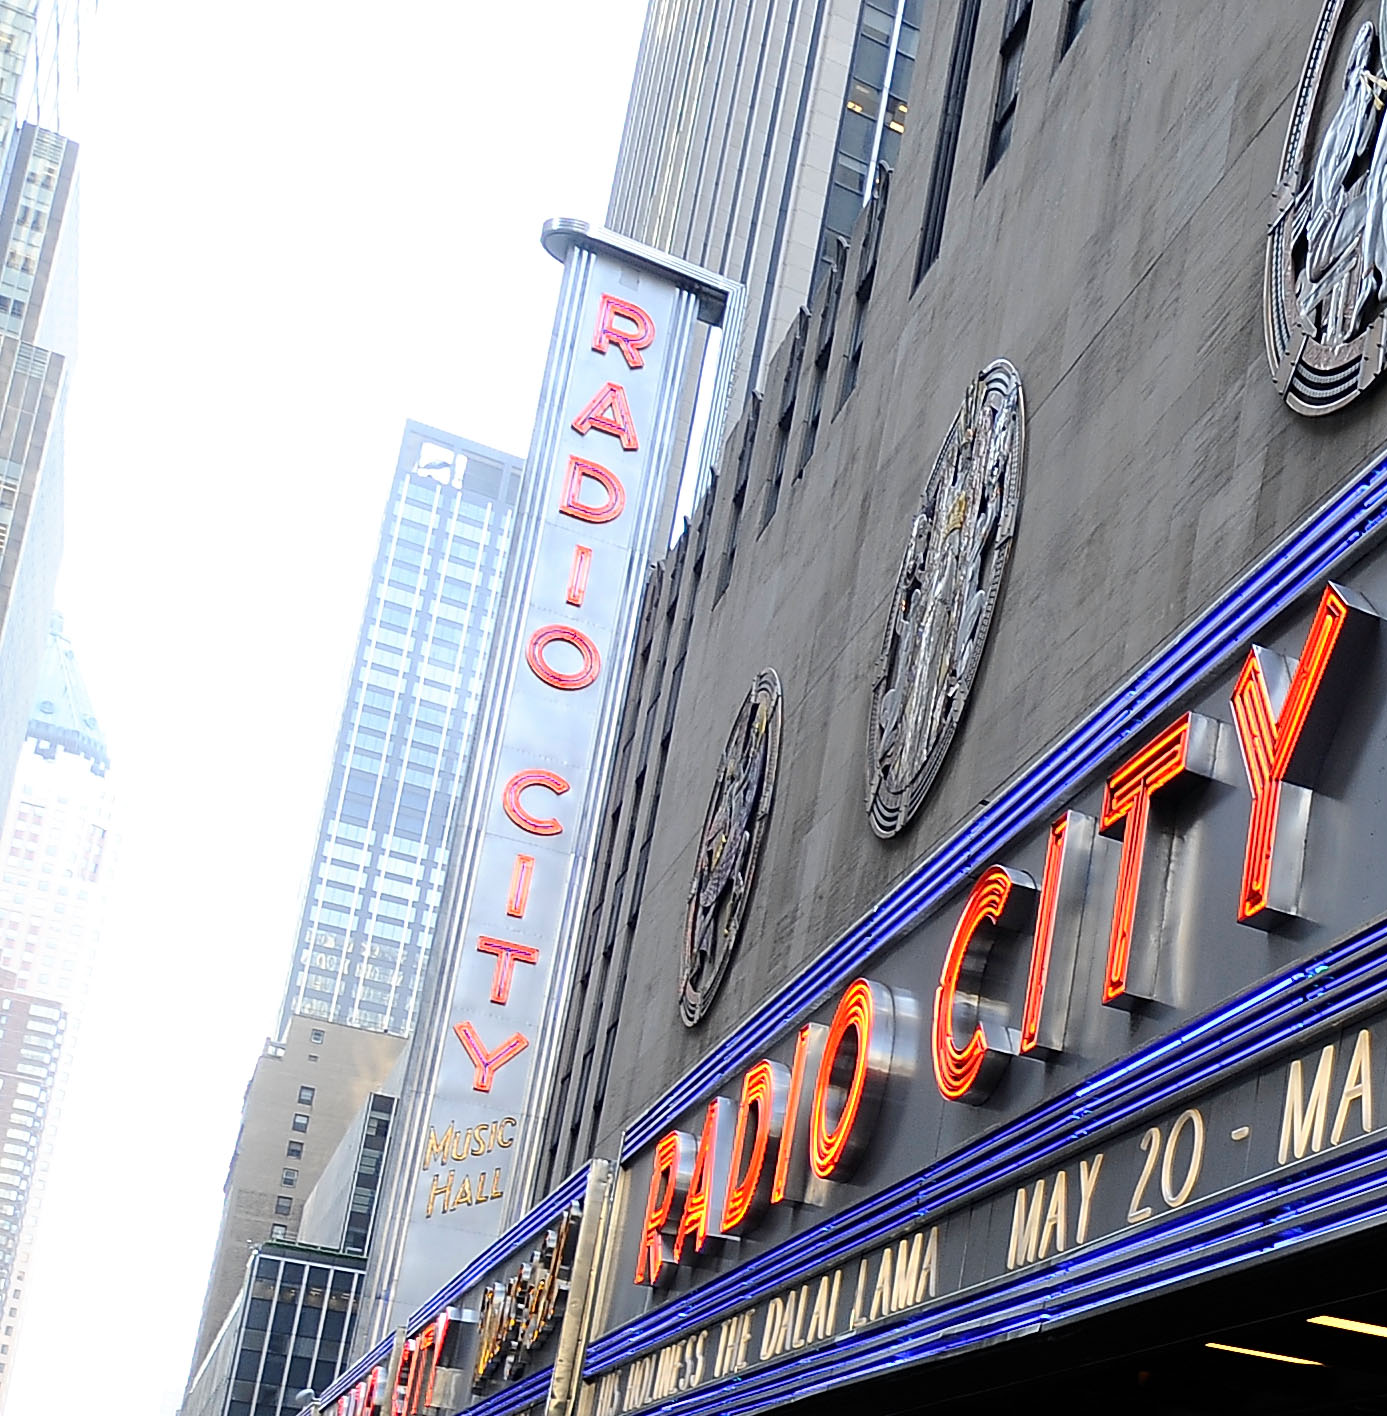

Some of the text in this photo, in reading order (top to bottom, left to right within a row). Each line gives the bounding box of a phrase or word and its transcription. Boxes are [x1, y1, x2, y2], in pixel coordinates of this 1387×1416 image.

[453, 293, 656, 1092] RADIO CITY
[632, 580, 1348, 1285] RADIO CITY
[423, 1115, 518, 1171] MUSIC
[427, 1167, 505, 1219] HALL
[713, 1307, 756, 1379] THE
[759, 1269, 843, 1361] DALAI
[849, 1225, 940, 1331] LAMA
[1007, 1153, 1104, 1270] MAY
[1127, 1108, 1204, 1224] 20
